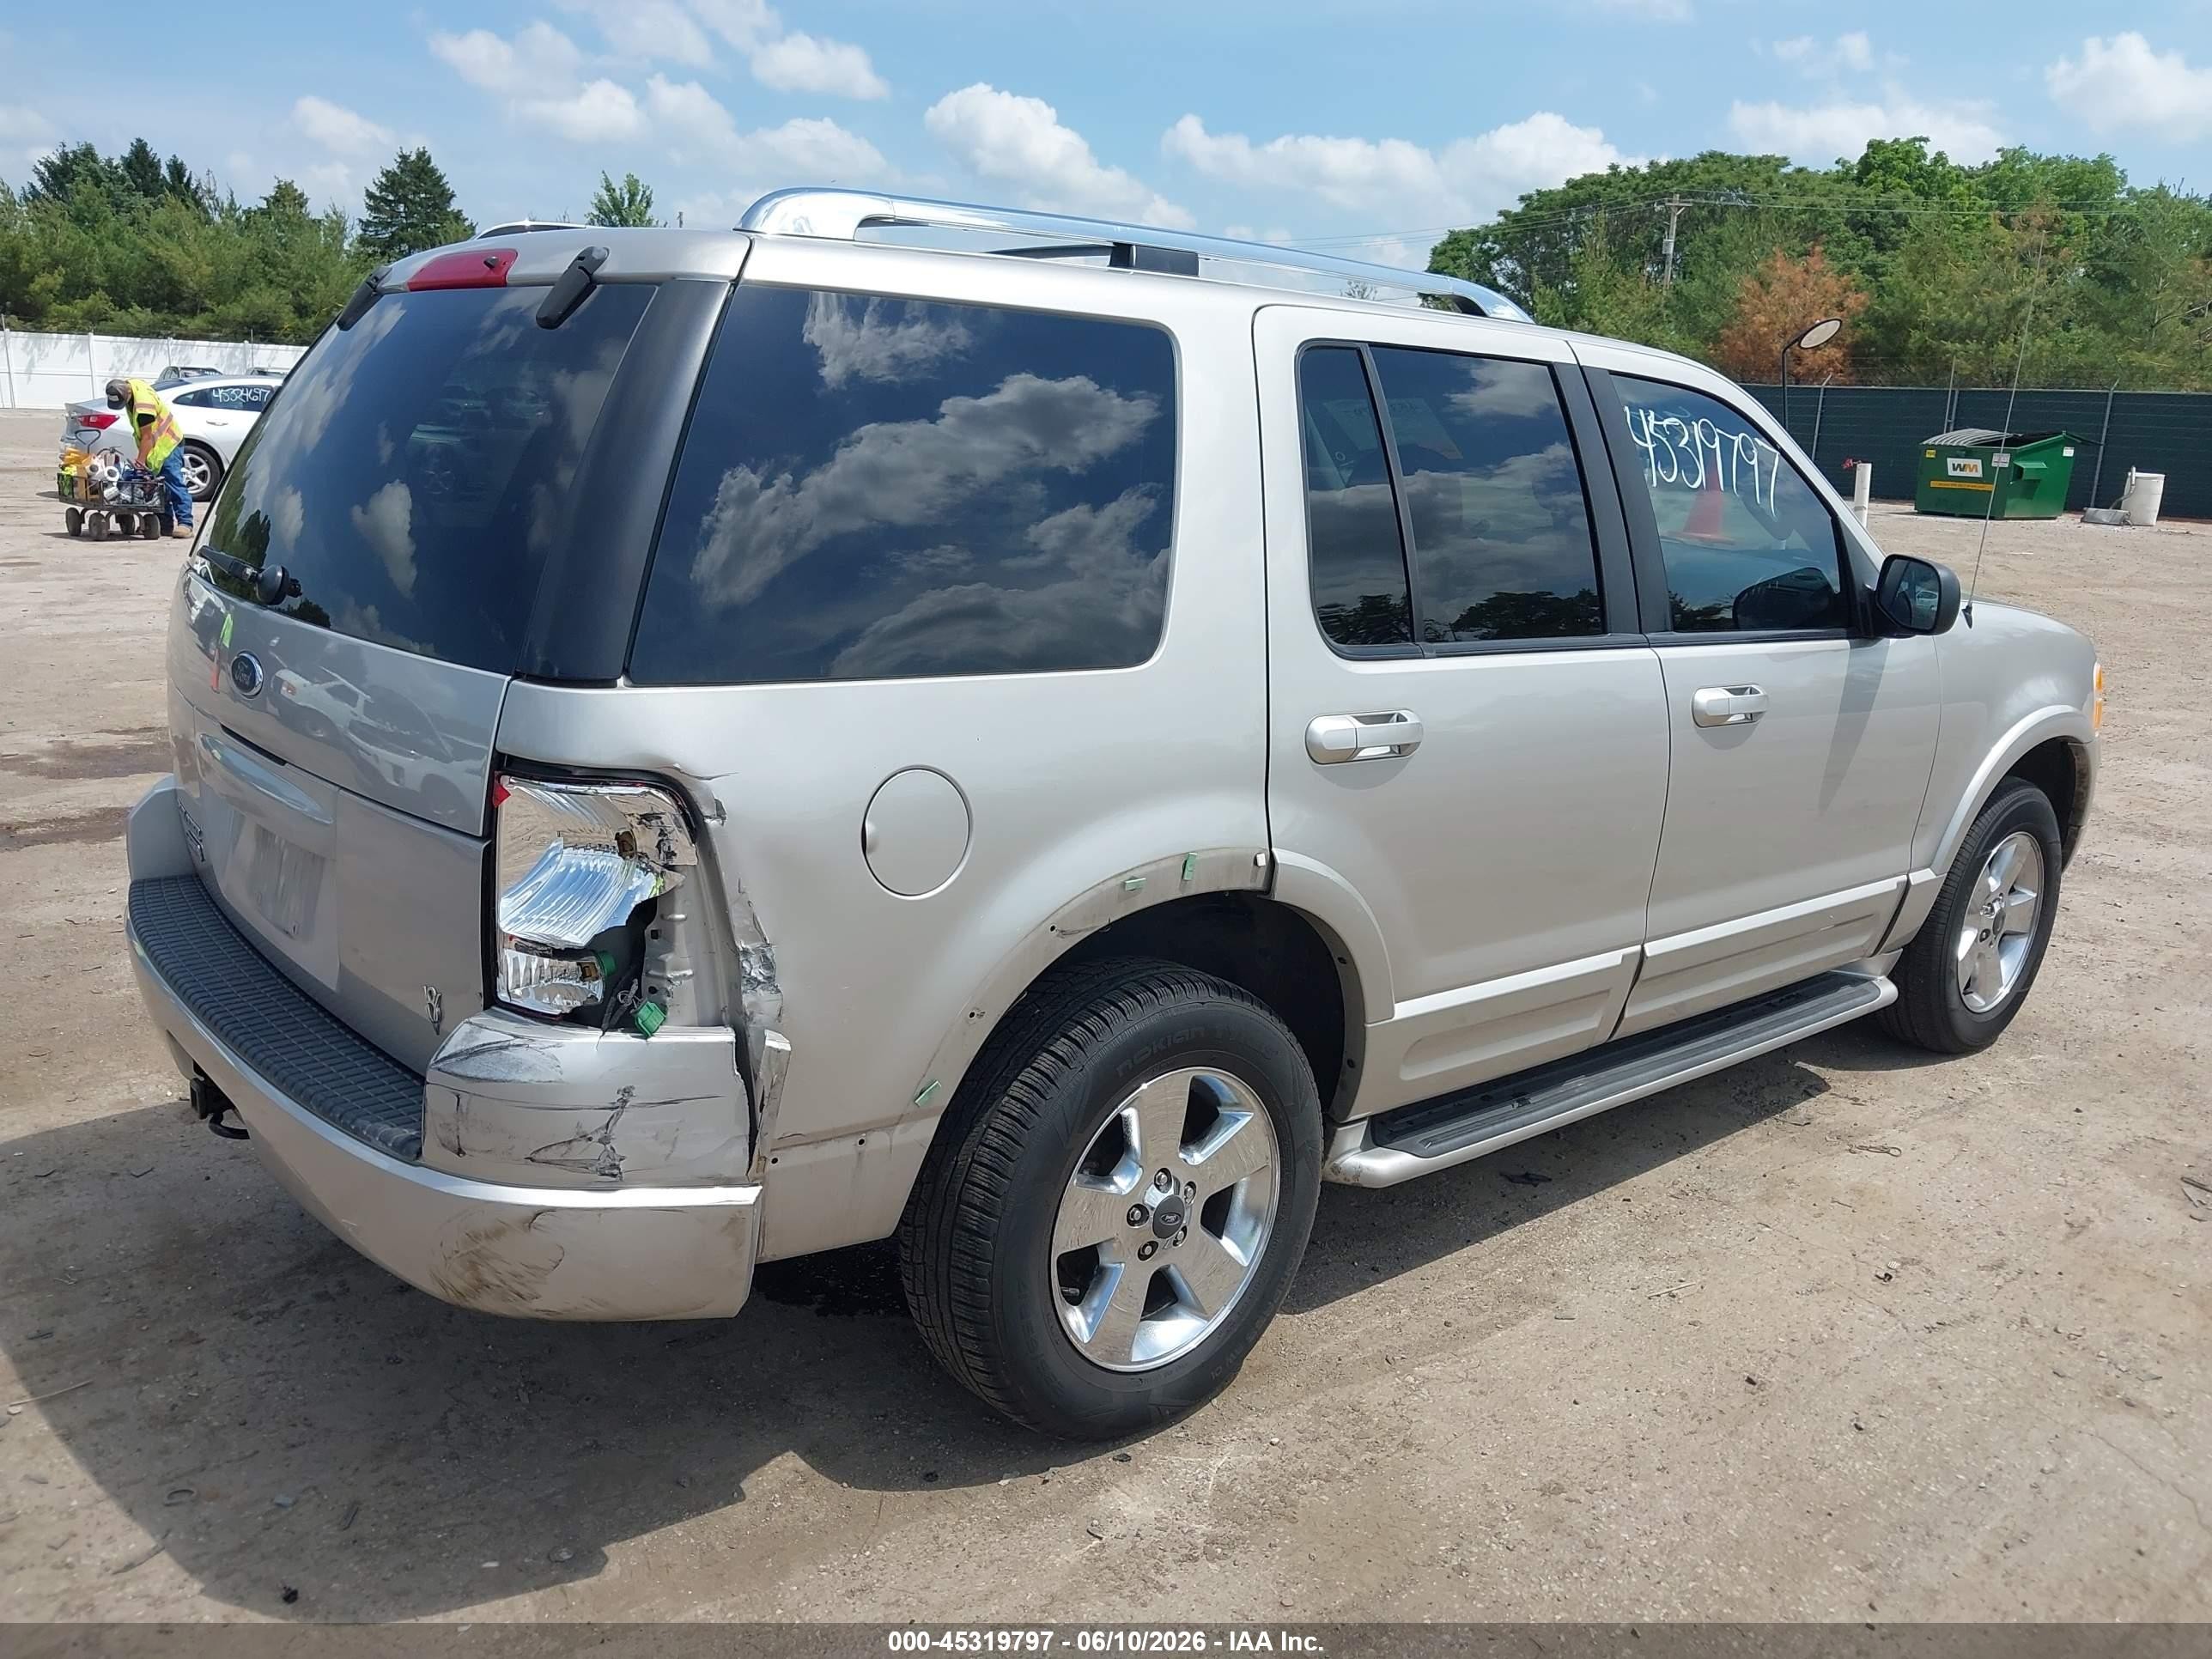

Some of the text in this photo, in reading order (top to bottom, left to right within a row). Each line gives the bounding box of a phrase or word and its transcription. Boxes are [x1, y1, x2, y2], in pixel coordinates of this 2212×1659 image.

[212, 387, 271, 403] 45324697
[1623, 405, 1780, 519] 45319797
[1951, 463, 1979, 473] WM
